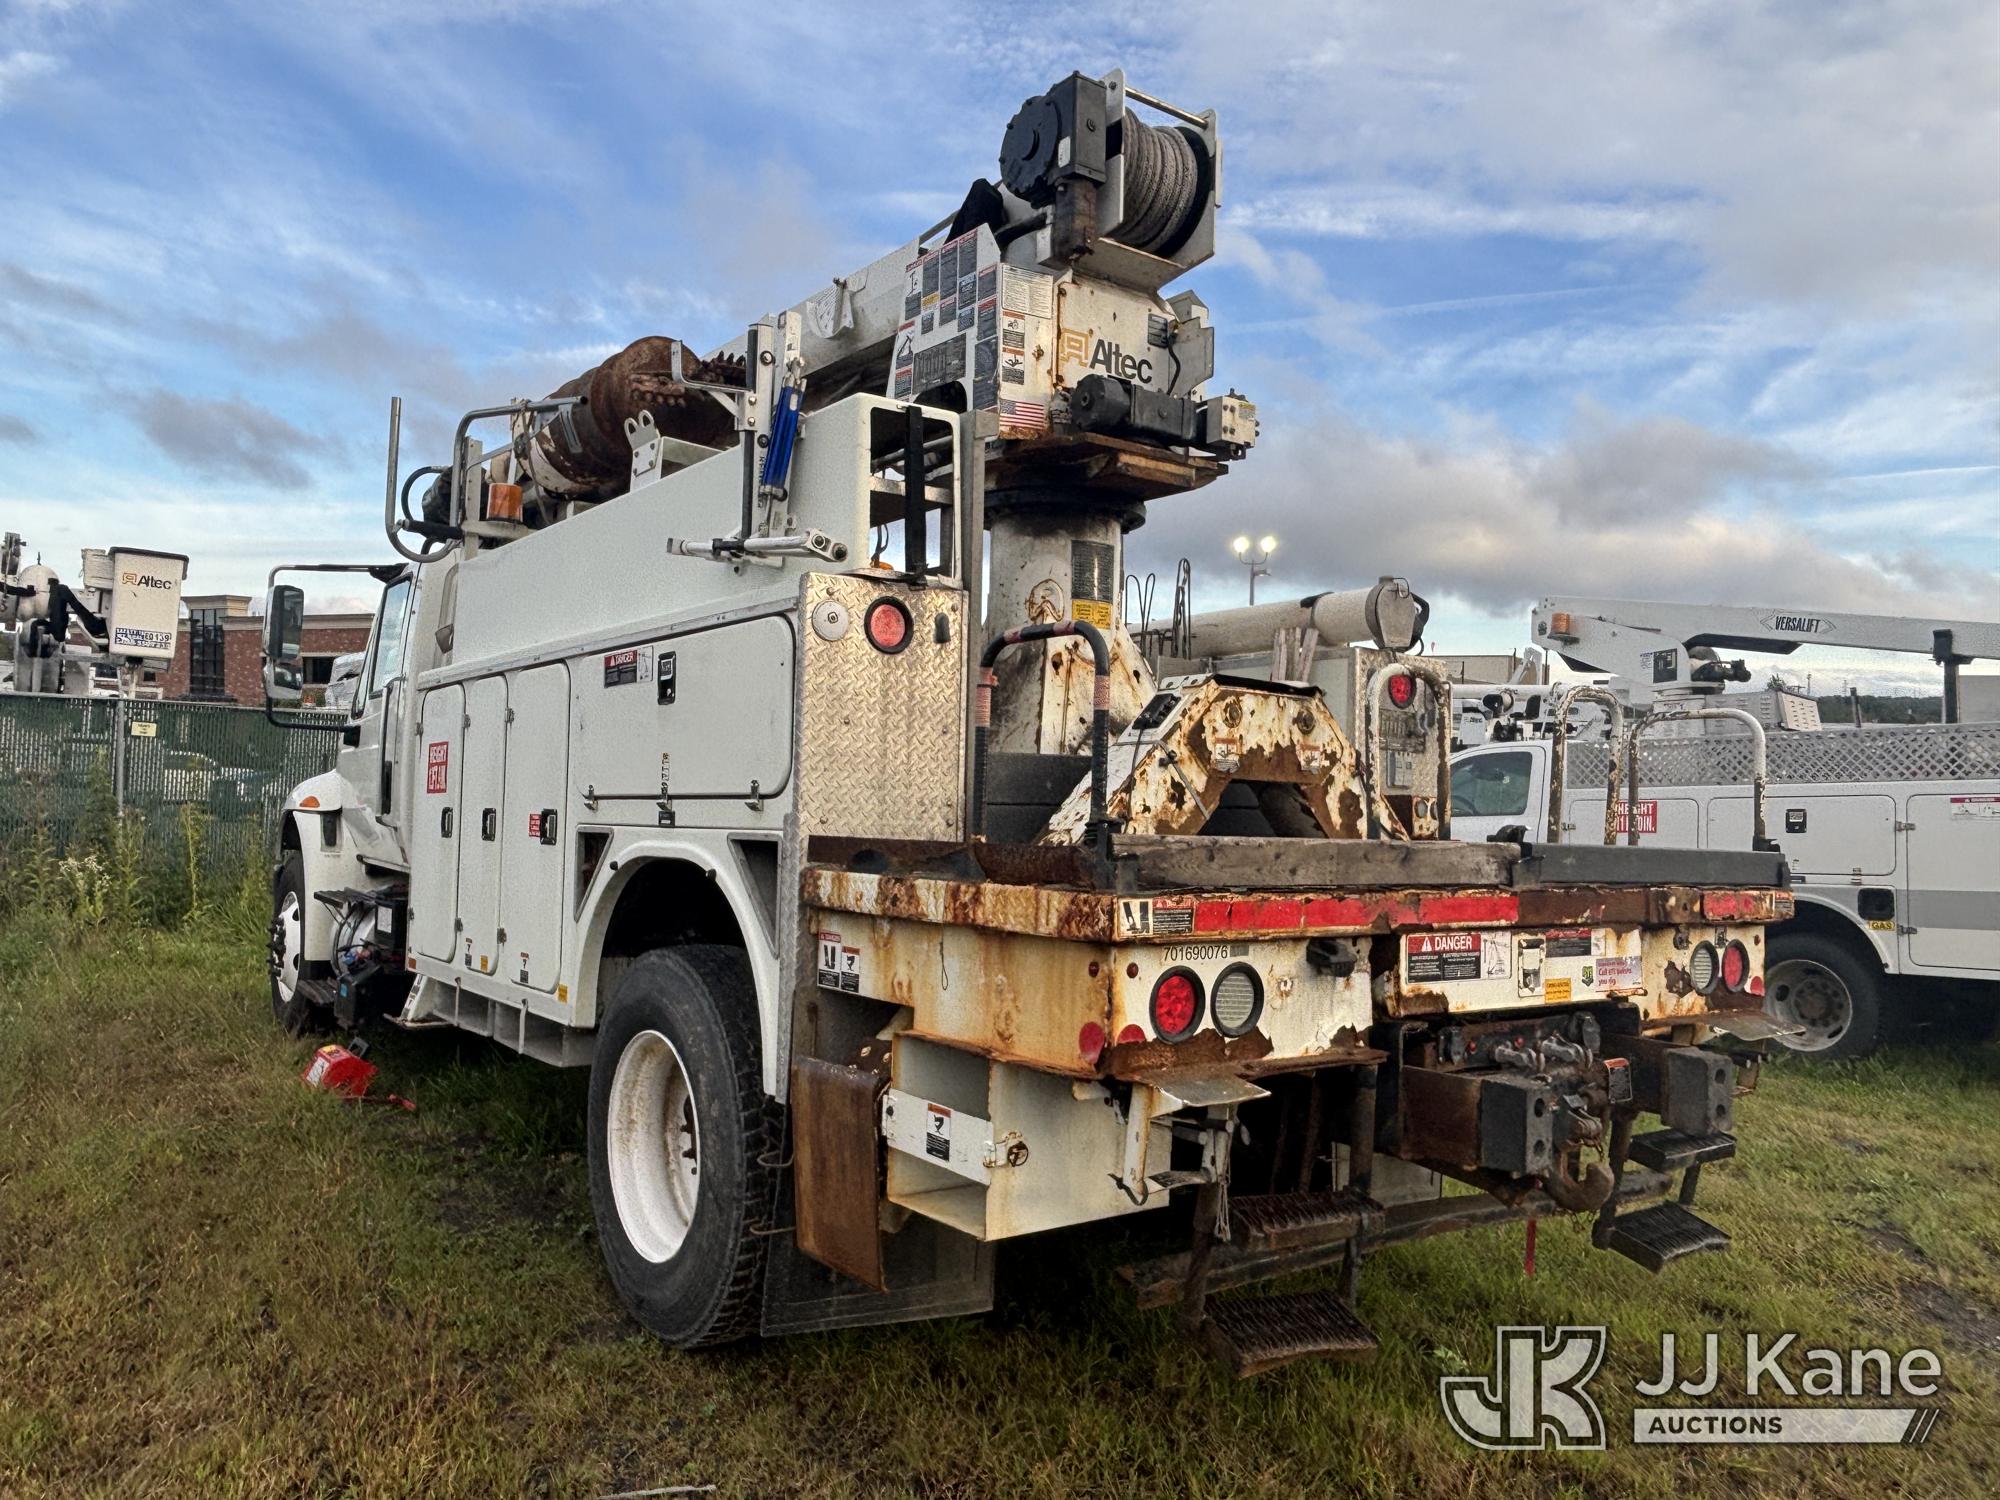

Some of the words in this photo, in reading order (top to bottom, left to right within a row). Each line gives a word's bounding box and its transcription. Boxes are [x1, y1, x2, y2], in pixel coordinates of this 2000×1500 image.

[1089, 339, 1153, 384] Altec
[137, 575, 172, 590] Altec
[1775, 615, 1821, 633] VERSALIFT
[1871, 921, 1893, 930] GAS
[1434, 936, 1473, 951] DANGER
[1163, 945, 1228, 961] 701690076
